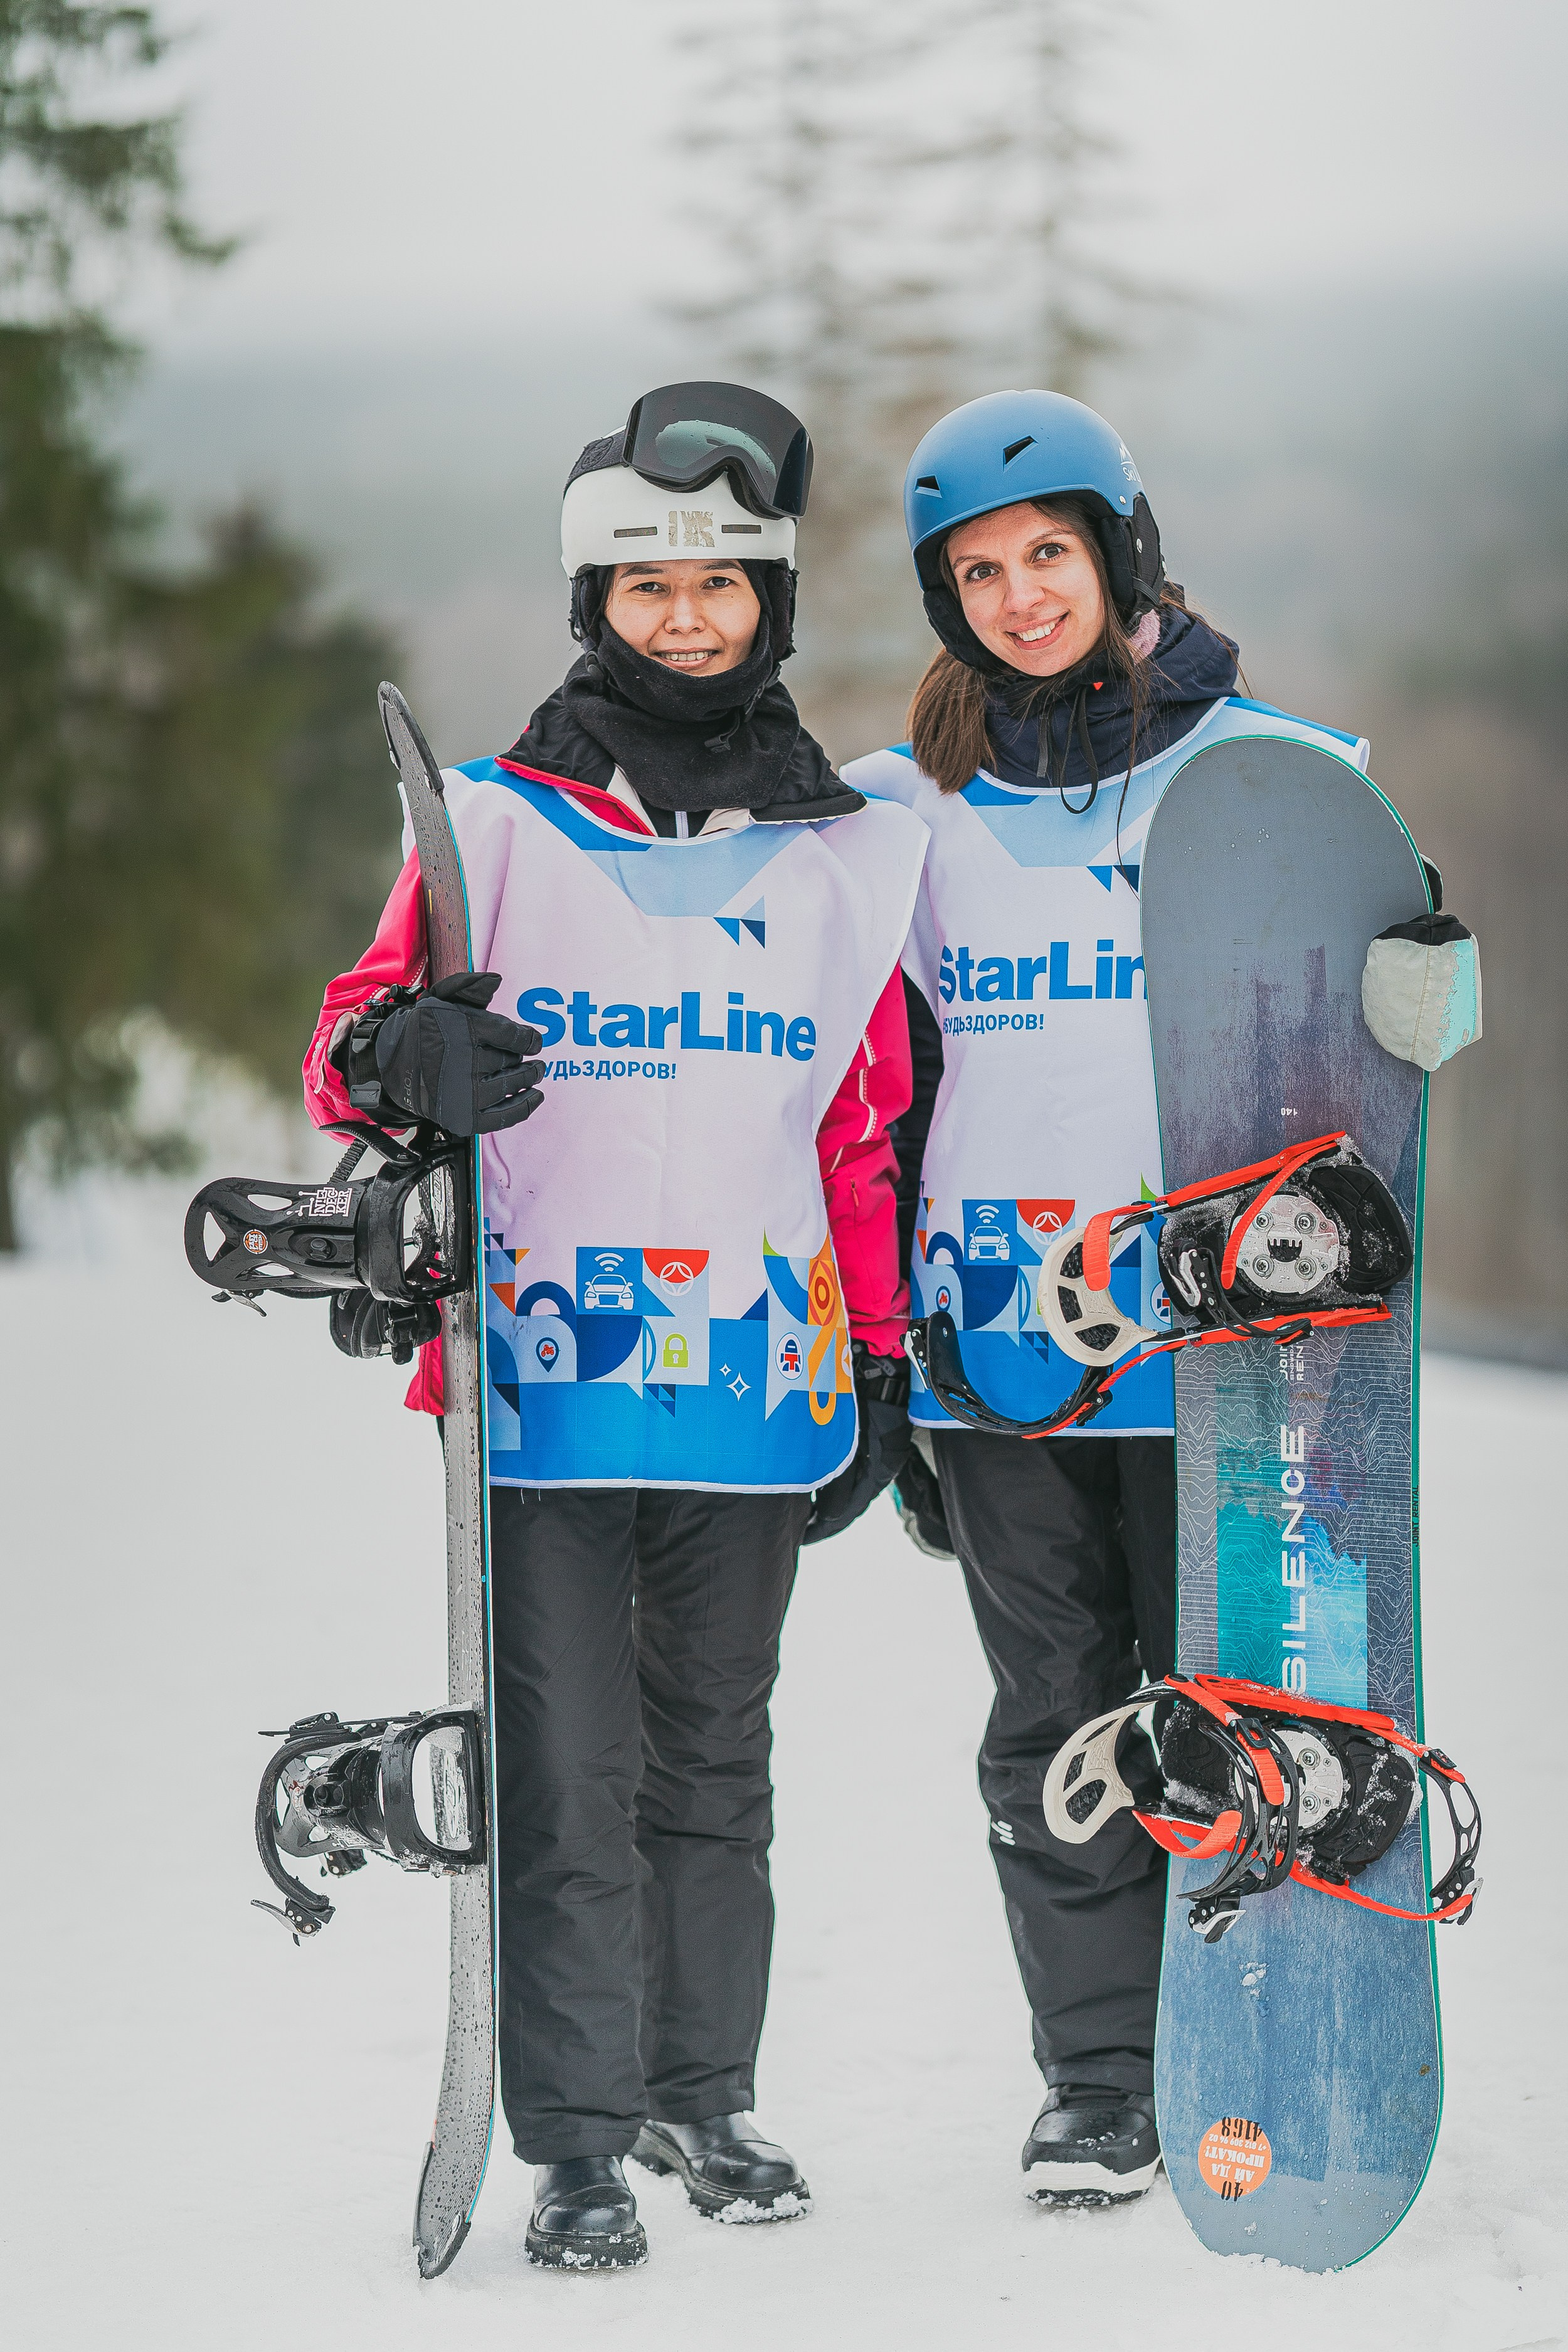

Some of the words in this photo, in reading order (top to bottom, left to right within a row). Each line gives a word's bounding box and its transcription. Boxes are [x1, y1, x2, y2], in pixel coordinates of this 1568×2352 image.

[939, 940, 1148, 1004] StarLin
[517, 987, 817, 1061] StarLine
[544, 1060, 676, 1081] УДЬЗДОРОВ!
[1281, 1107, 1298, 1116] 140
[336, 1190, 349, 1214] KER
[1280, 1424, 1306, 1693] SILENCE
[1209, 2133, 1219, 2143] 02
[1221, 2116, 1263, 2142] 4168
[1230, 2137, 1244, 2147] 309
[1244, 2139, 1258, 2150] 812
[1258, 2143, 1267, 2151] +7
[1204, 2145, 1265, 2168] ПРОКАТ!
[1211, 2163, 1232, 2178] ДА
[1234, 2168, 1255, 2183] АЙ
[1221, 2180, 1244, 2202] 40
